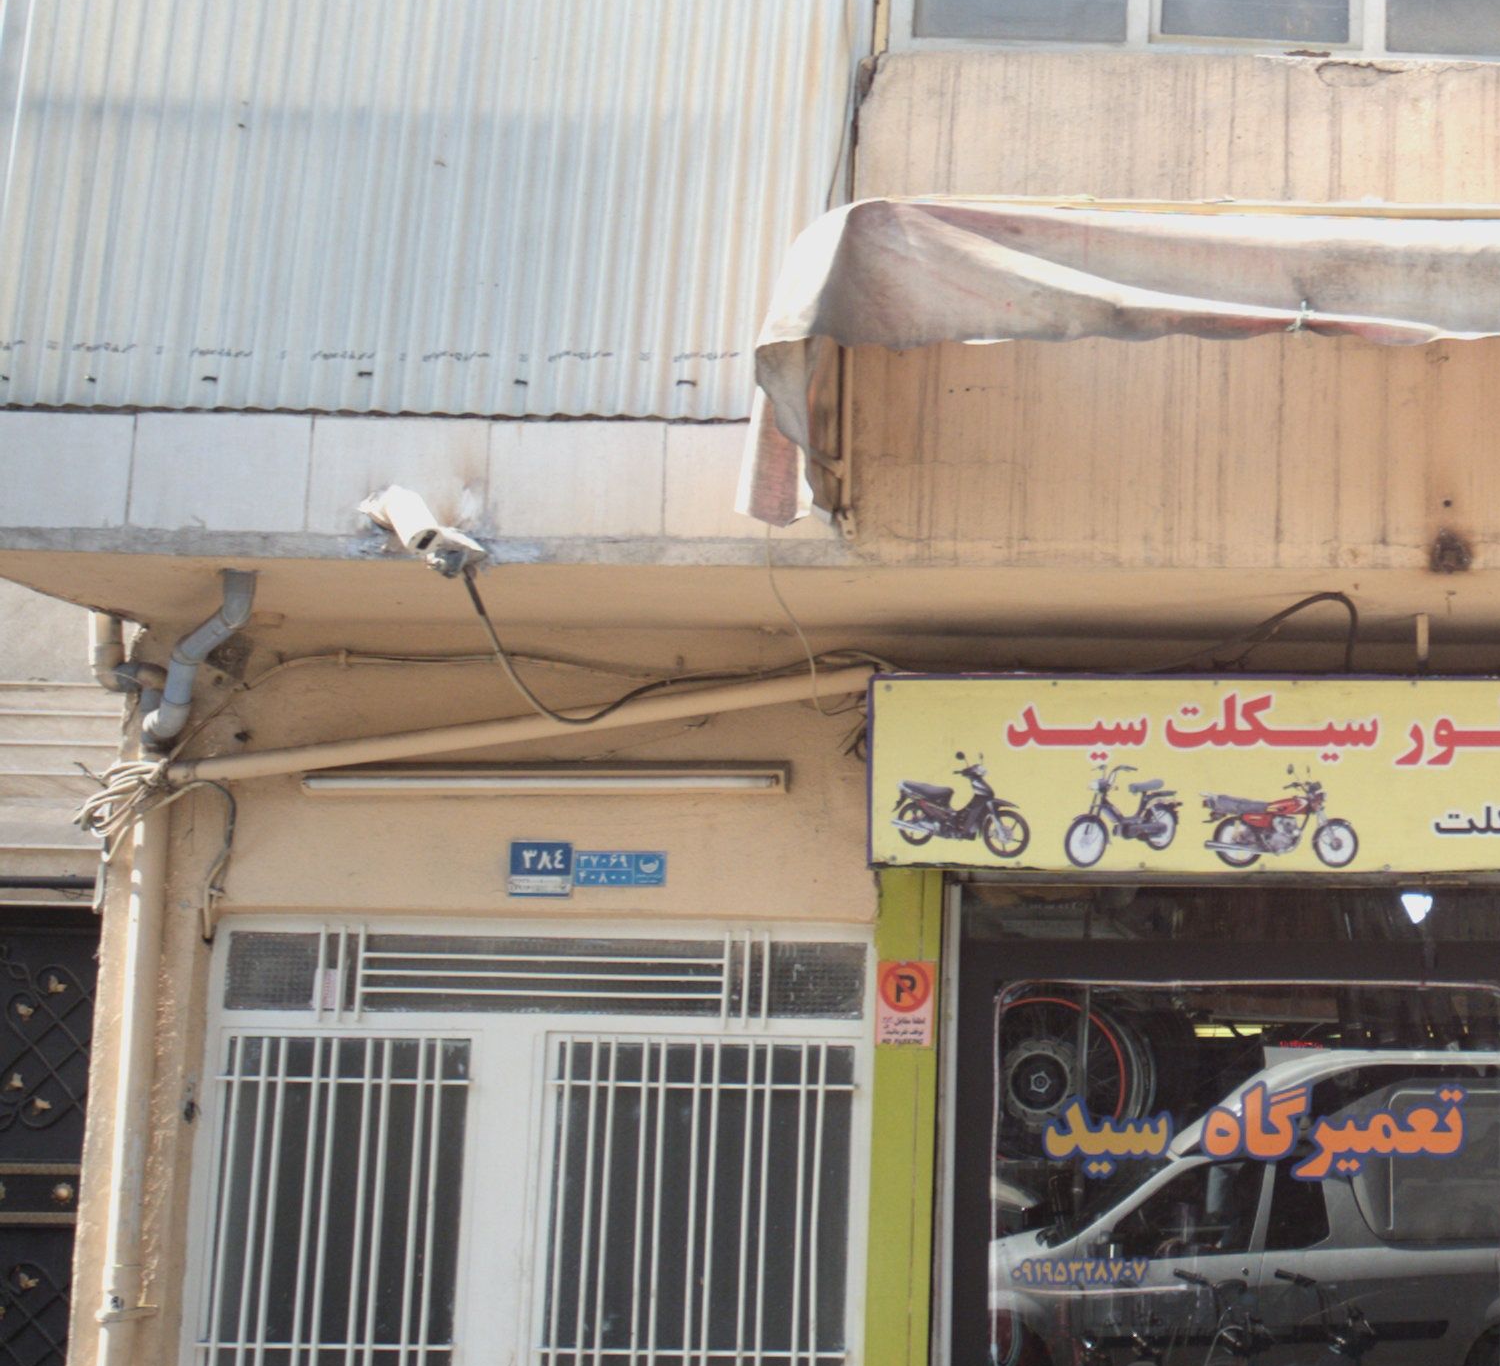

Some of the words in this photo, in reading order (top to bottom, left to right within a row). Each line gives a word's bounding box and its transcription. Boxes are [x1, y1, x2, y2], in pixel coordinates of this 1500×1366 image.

[1006, 705, 1148, 762] سید
[1164, 692, 1379, 762] سیکلت
[1043, 1094, 1173, 1178] سید
